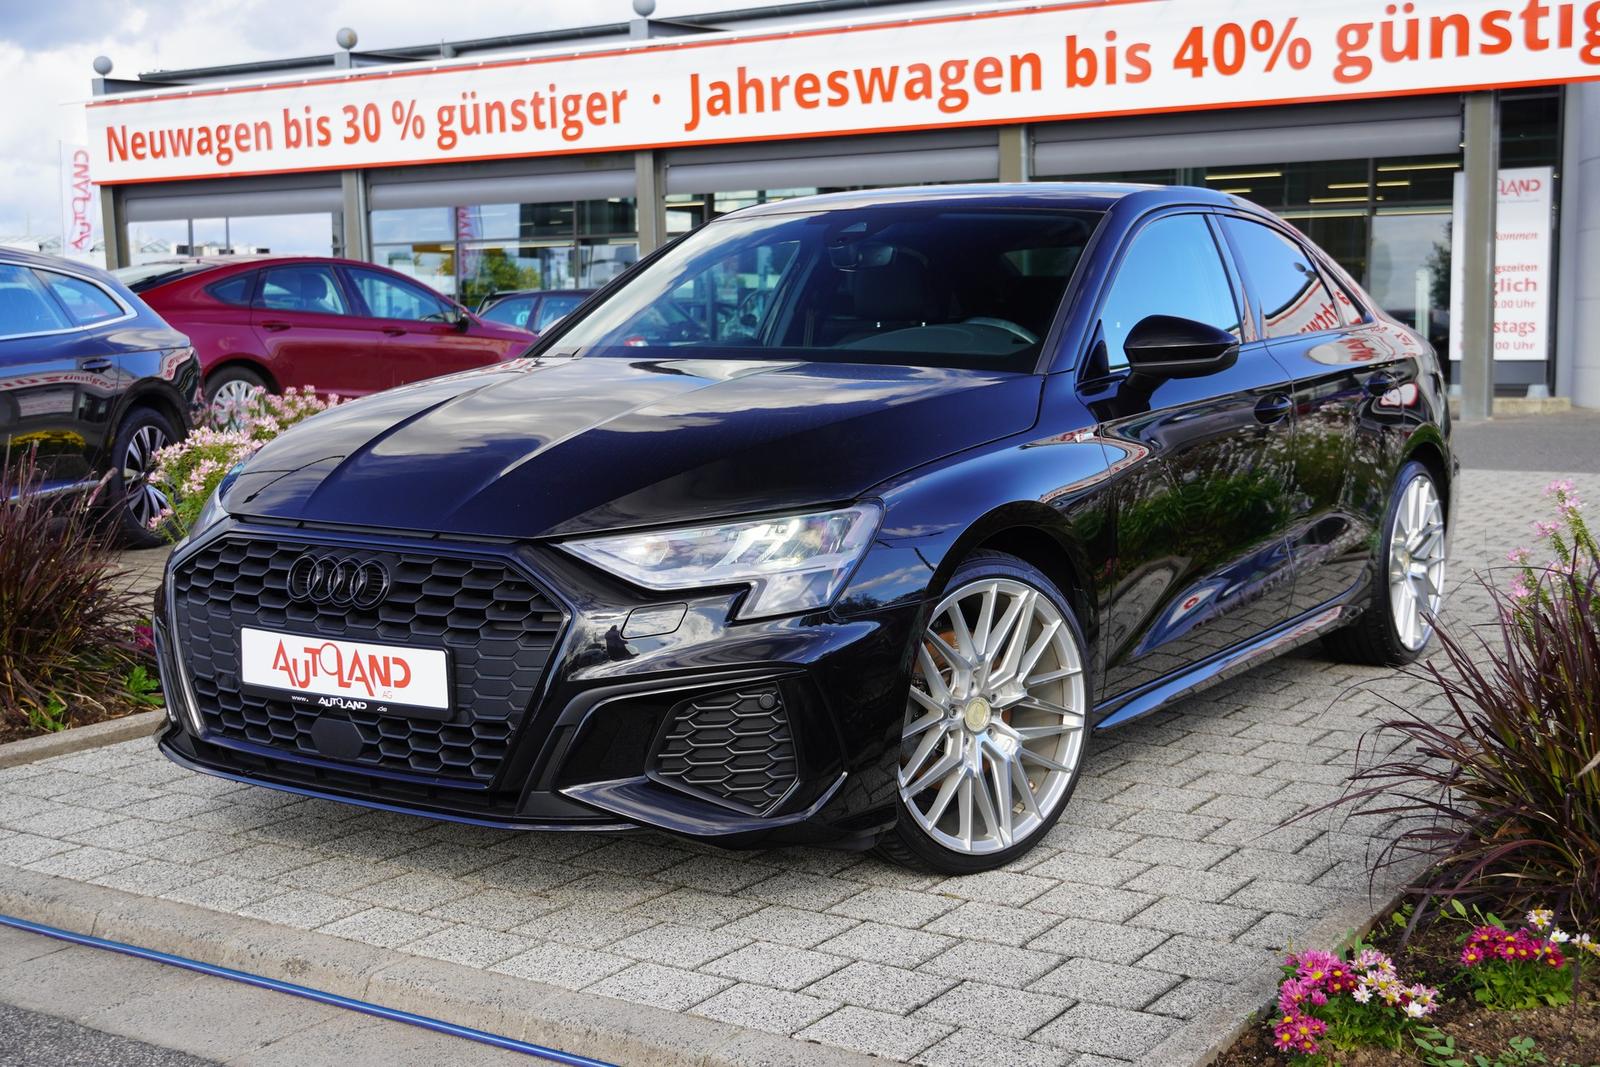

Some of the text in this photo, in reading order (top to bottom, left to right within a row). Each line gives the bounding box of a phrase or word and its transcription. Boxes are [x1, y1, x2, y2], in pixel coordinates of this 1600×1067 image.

[106, 121, 273, 166] Neuwagen
[283, 106, 332, 149] bis
[343, 103, 382, 145] 30
[391, 100, 426, 140] %
[436, 83, 628, 150] günstiger
[684, 56, 1043, 131] Jahreswagen
[1065, 30, 1153, 89] bis
[1172, 16, 1313, 79] 40%
[1497, 177, 1541, 197] LAND
[1495, 231, 1538, 241] kommen
[1492, 321, 1536, 337] stags
